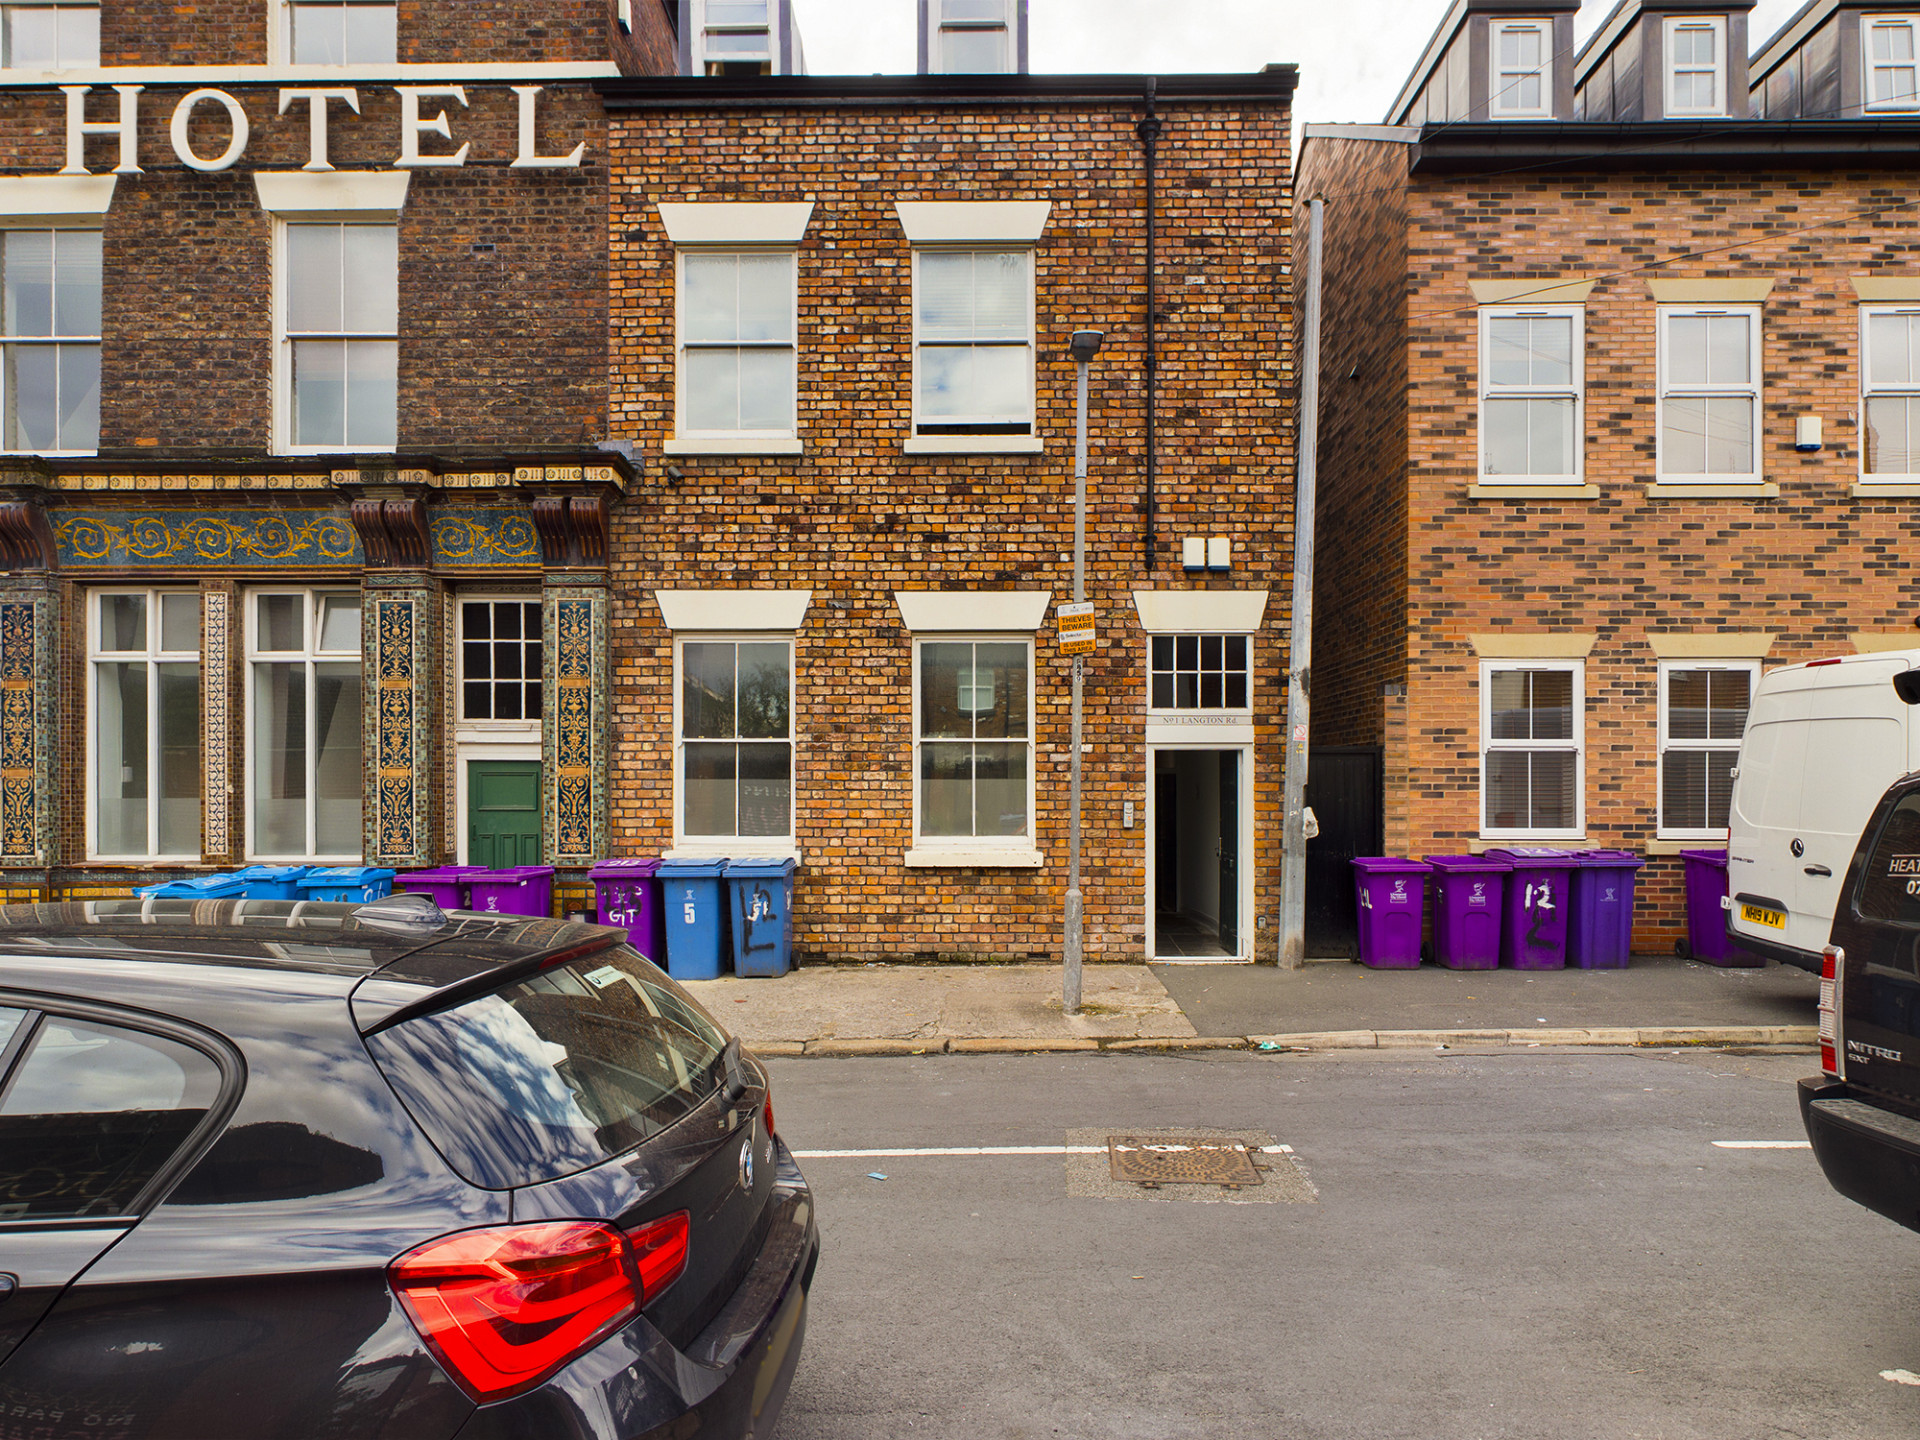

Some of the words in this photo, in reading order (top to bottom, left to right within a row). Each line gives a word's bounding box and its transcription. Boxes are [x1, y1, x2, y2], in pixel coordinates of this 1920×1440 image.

[58, 84, 587, 175] HOTEL
[1062, 615, 1092, 623] THIEVES
[1062, 622, 1093, 631] BEWARE
[683, 902, 696, 924] 5
[1744, 905, 1763, 921] NH19
[1763, 911, 1781, 926] WJV
[1847, 1039, 1902, 1062] NITRO
[1848, 1053, 1871, 1064] SXT
